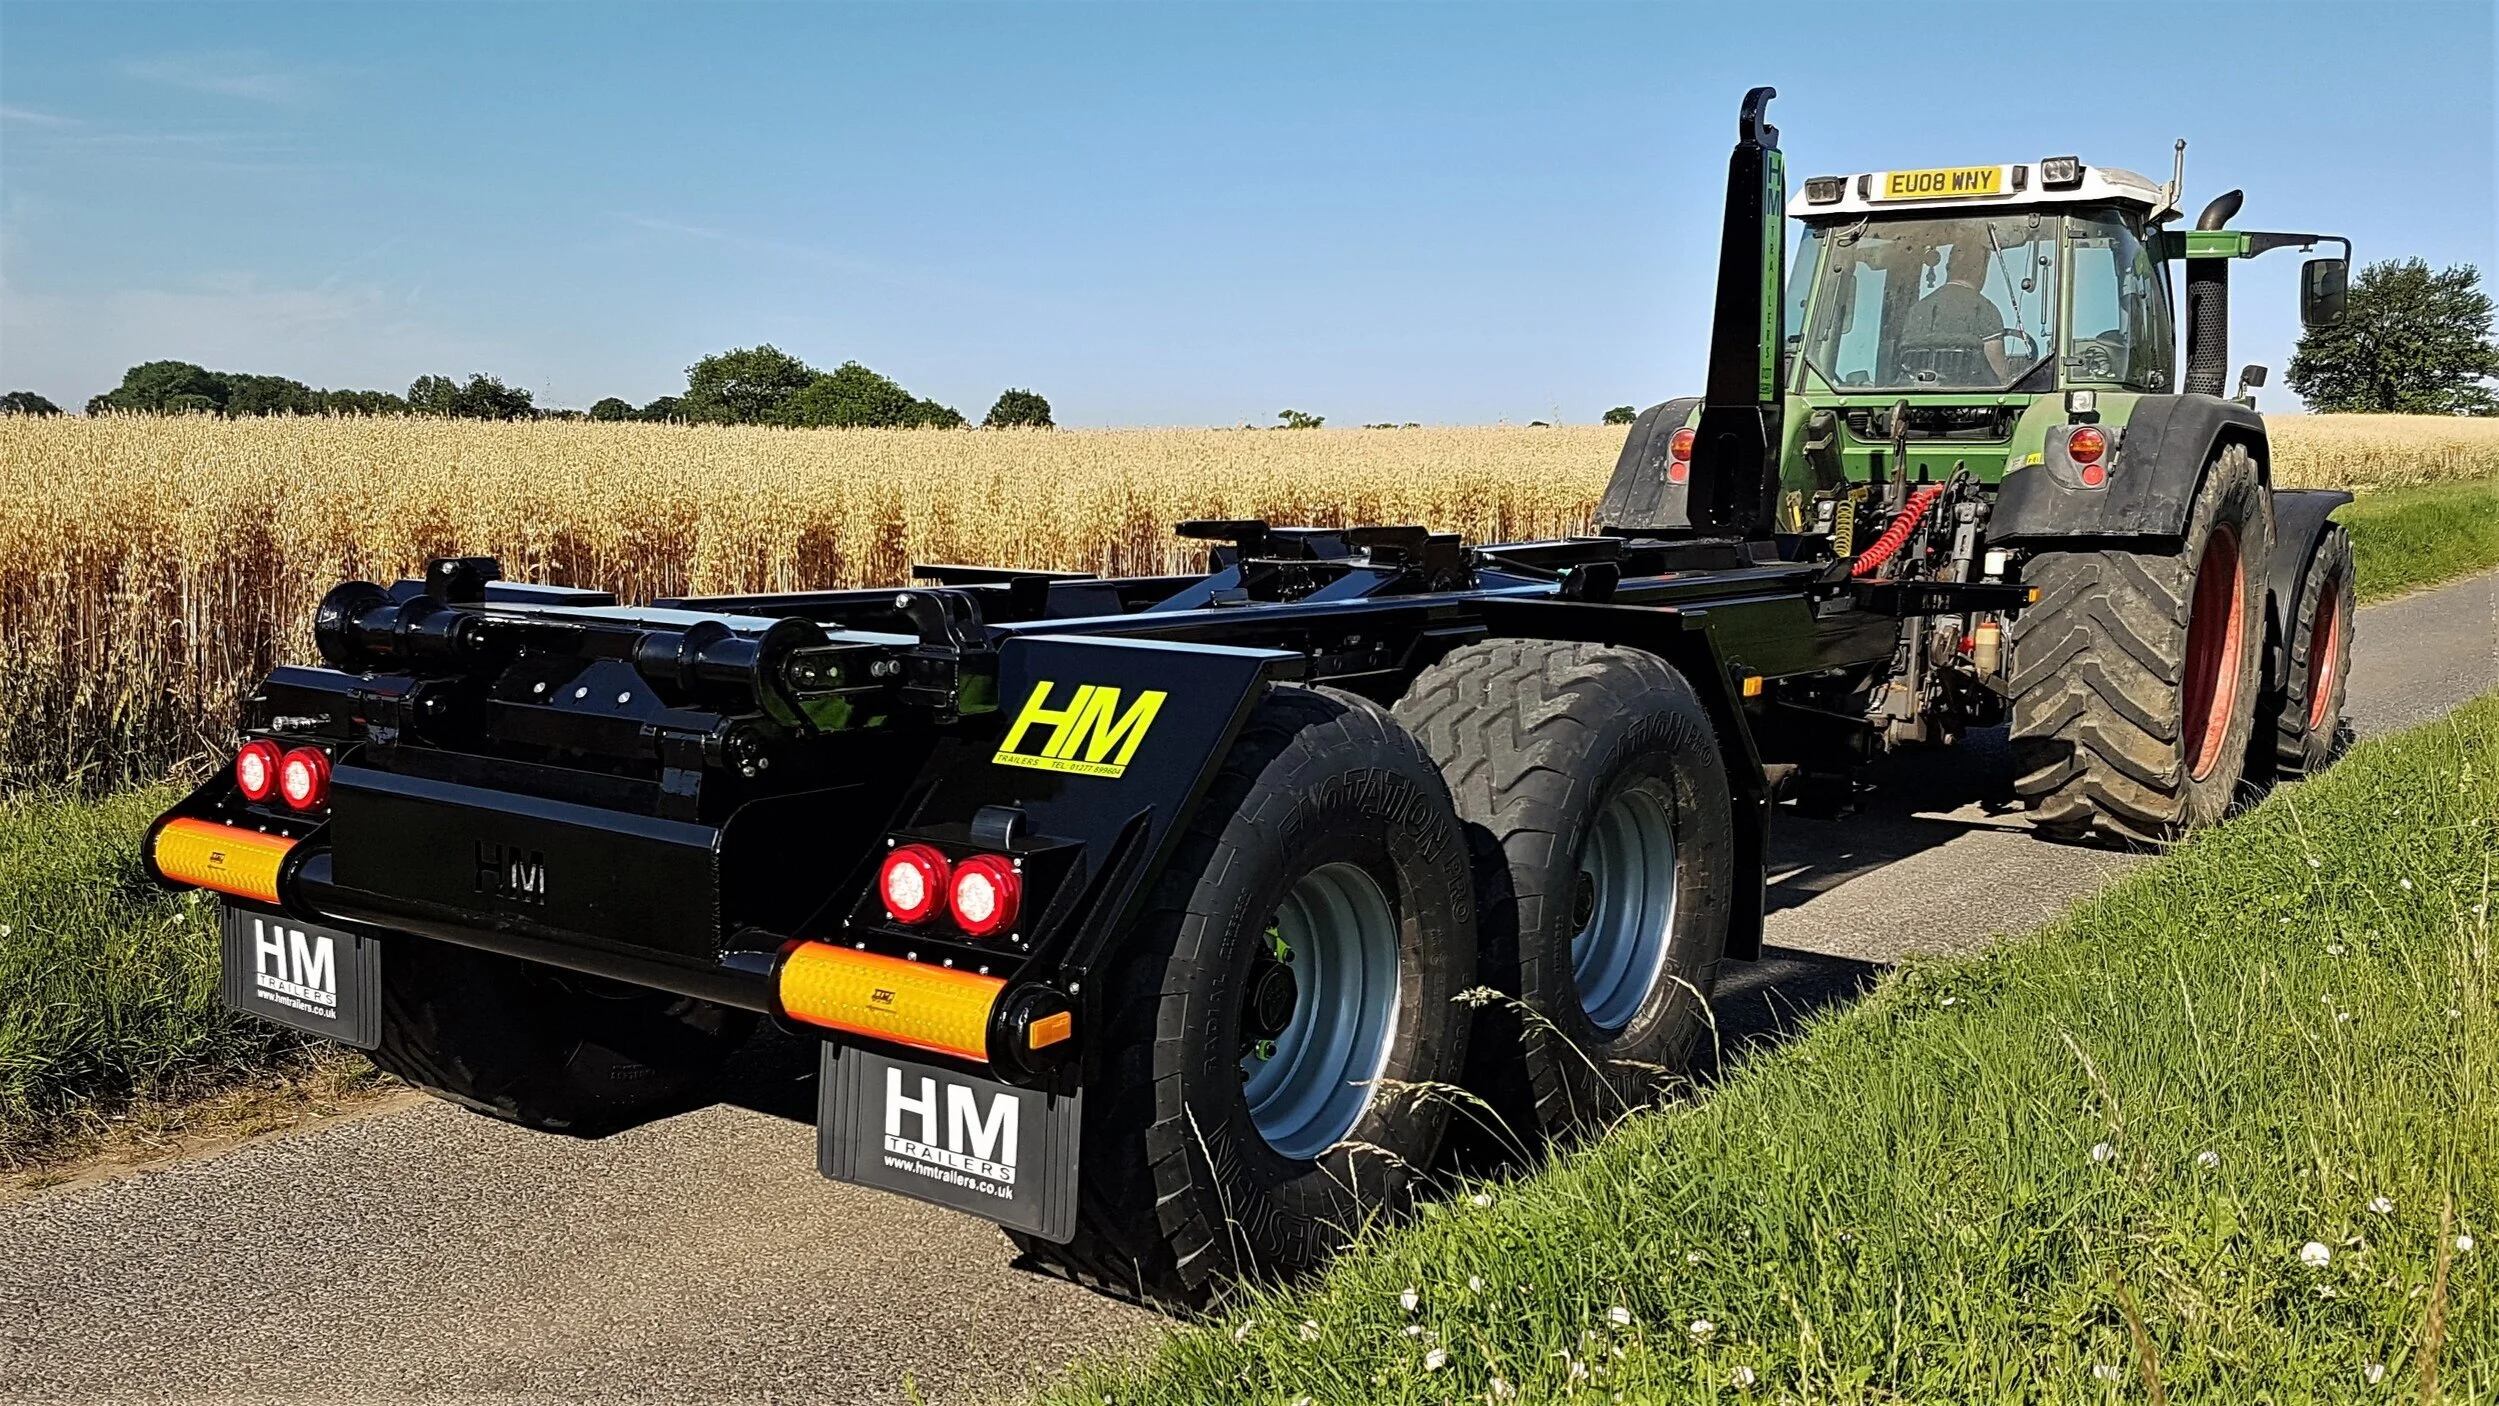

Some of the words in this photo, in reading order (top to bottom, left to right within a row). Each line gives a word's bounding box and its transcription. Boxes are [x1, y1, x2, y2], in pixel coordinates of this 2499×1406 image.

[1767, 157, 1780, 217] HM
[1892, 174, 1945, 193] EU08
[1952, 170, 1992, 190] WNY
[999, 681, 1168, 766] HM
[997, 754, 1040, 767] TRAILERS
[475, 840, 544, 905] HM
[255, 918, 336, 994] HM
[257, 989, 337, 1019] www.hmtrailers.co.uk
[260, 975, 334, 1005] TRAILERS
[1203, 974, 1228, 1078] RADIAL
[885, 1066, 1020, 1168] HM
[884, 1155, 1013, 1200] www.hmtrailers.co.uk
[890, 1137, 1011, 1181] TRAILERS
